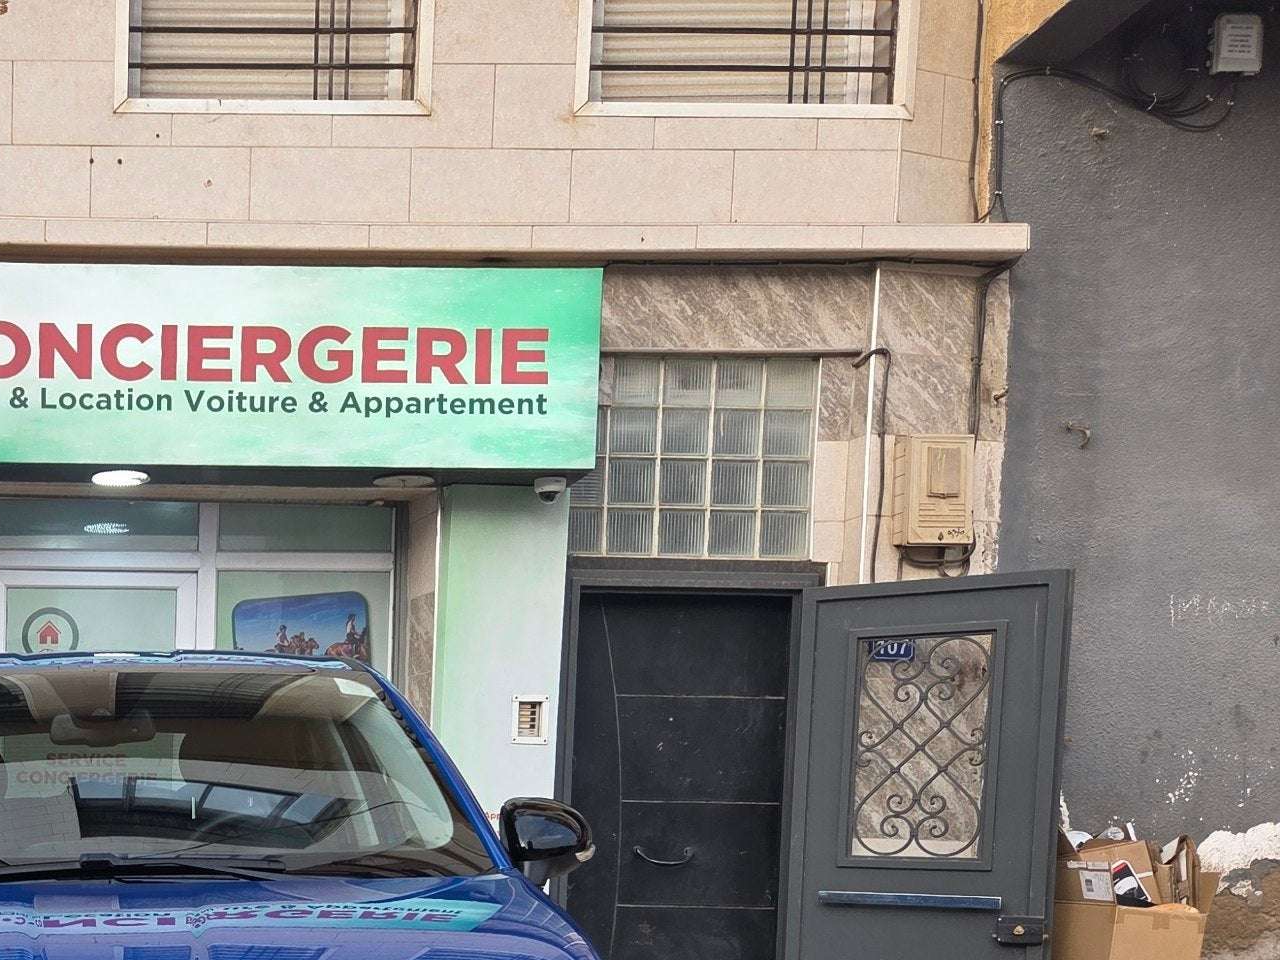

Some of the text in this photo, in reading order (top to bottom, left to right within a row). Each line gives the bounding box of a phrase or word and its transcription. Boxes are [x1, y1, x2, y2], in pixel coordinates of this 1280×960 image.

[10, 386, 29, 409] &
[41, 387, 172, 412] Location
[184, 389, 297, 414] Voiture
[308, 390, 328, 414] &
[339, 391, 548, 418] Appartement
[46, 753, 127, 767] SERVICE
